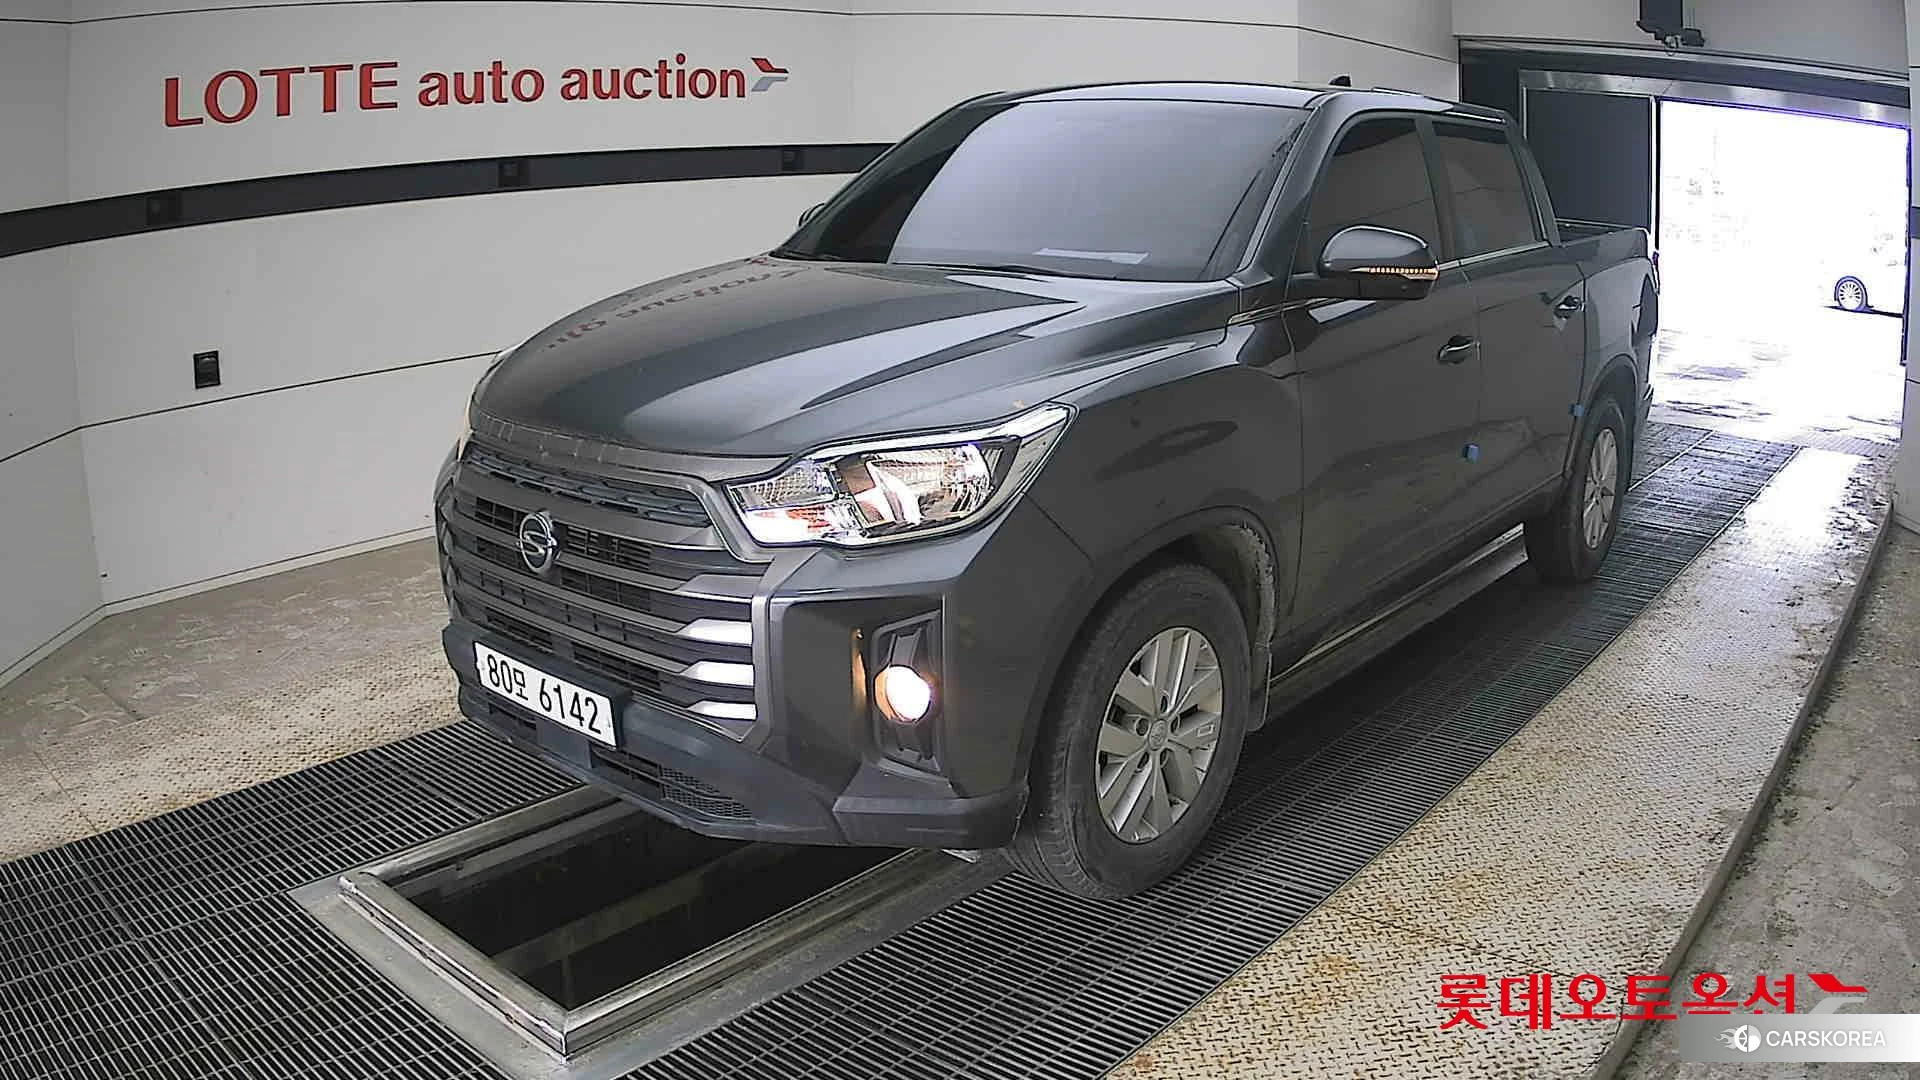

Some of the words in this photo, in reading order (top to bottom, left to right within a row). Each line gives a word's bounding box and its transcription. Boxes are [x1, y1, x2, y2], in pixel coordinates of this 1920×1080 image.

[164, 61, 399, 127] LOTTE
[418, 61, 545, 107] auto
[561, 53, 747, 101] auction
[486, 653, 529, 701] 80모
[539, 678, 602, 735] 6142
